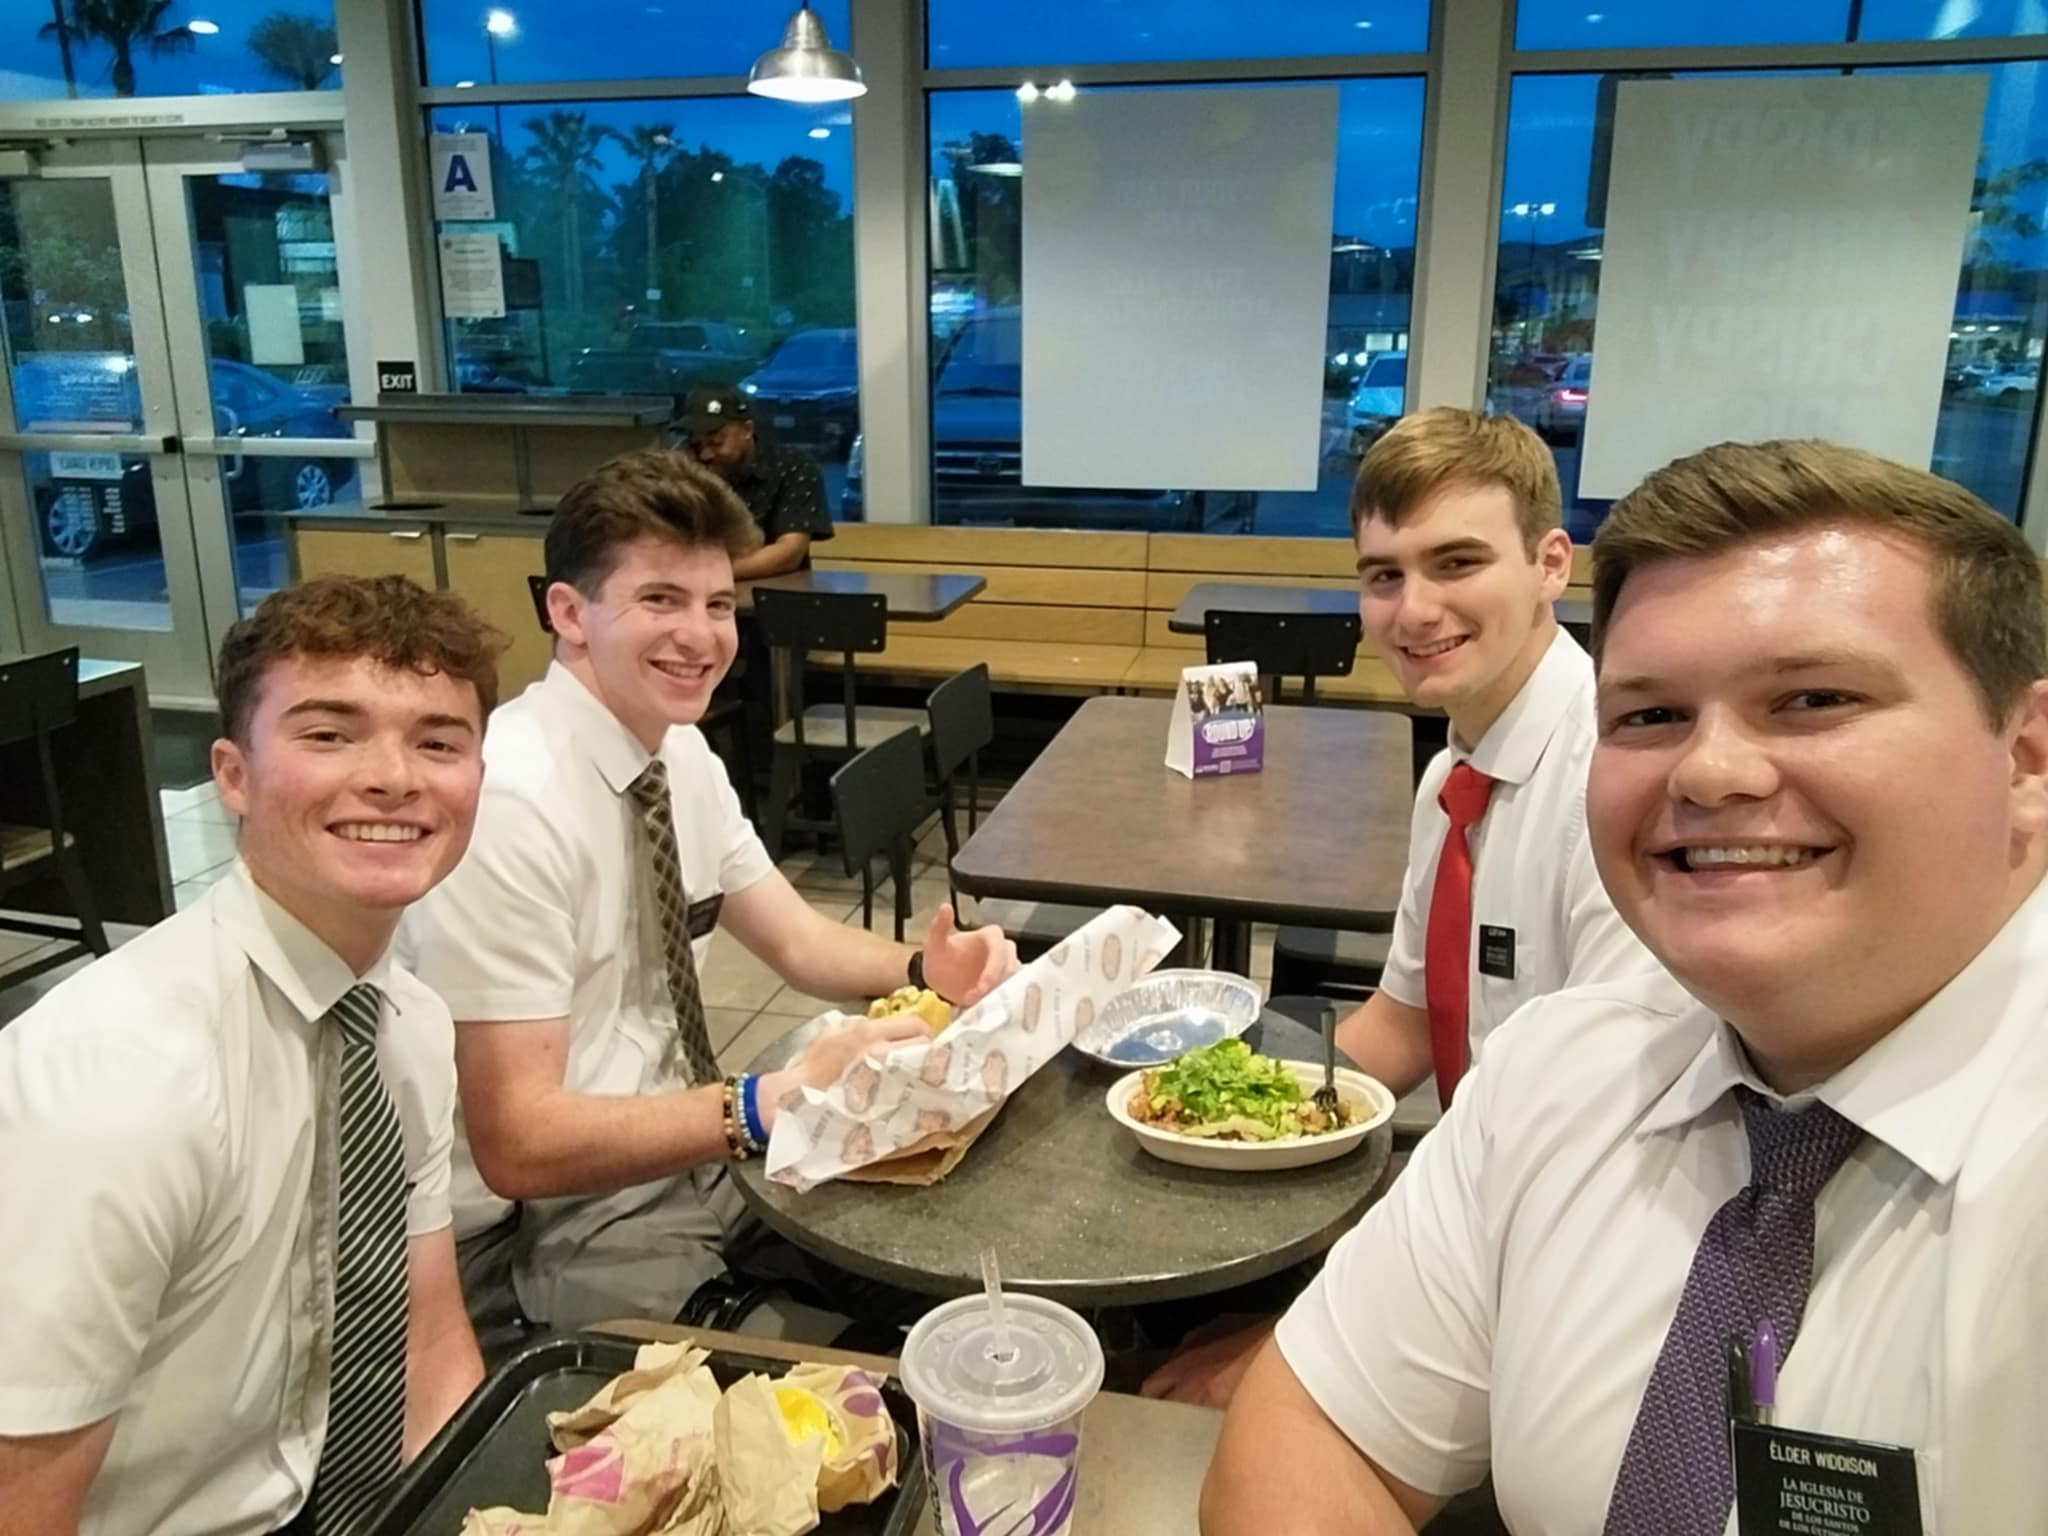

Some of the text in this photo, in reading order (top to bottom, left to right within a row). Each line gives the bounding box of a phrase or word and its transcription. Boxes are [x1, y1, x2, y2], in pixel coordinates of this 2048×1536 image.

[444, 154, 478, 192] A
[381, 373, 413, 389] EXIT
[1814, 1451, 1878, 1478] WIDDISON
[1782, 1477, 1864, 1504] LA IGLESIA DE
[1780, 1491, 1870, 1524] JESUCRISTO
